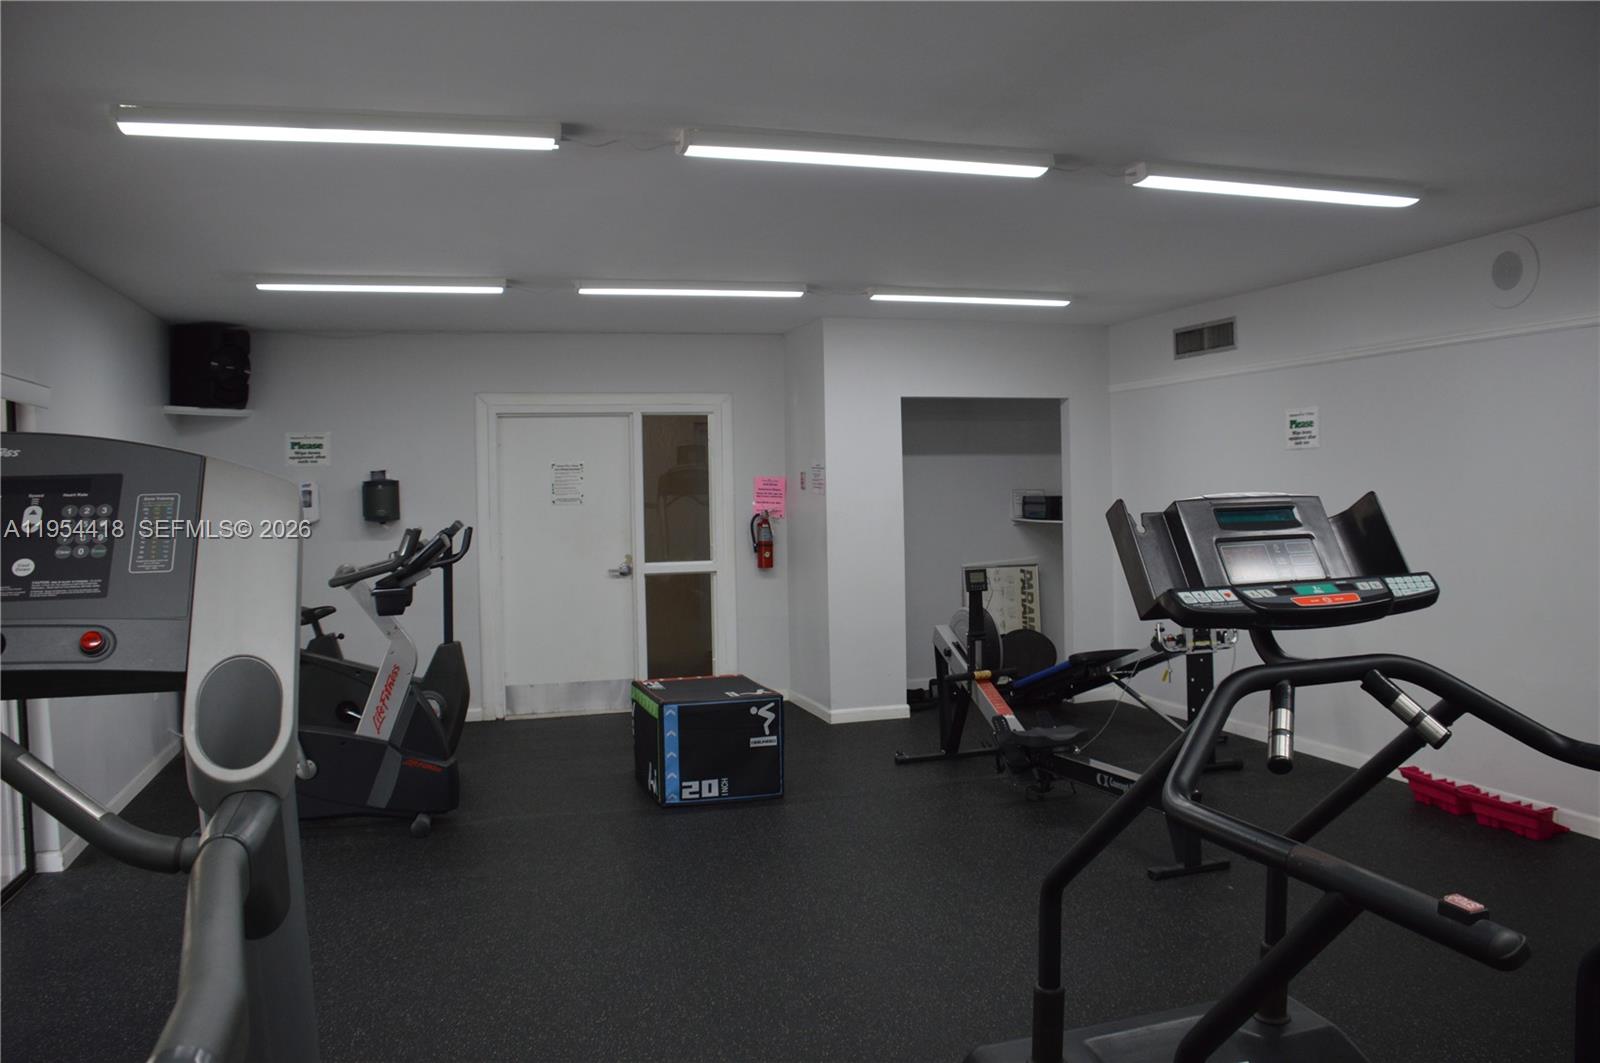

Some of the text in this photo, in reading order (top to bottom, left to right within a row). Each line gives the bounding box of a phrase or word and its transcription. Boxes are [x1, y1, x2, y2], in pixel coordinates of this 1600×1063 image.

[290, 441, 324, 450] Please
[681, 777, 729, 800] 20 INCH
